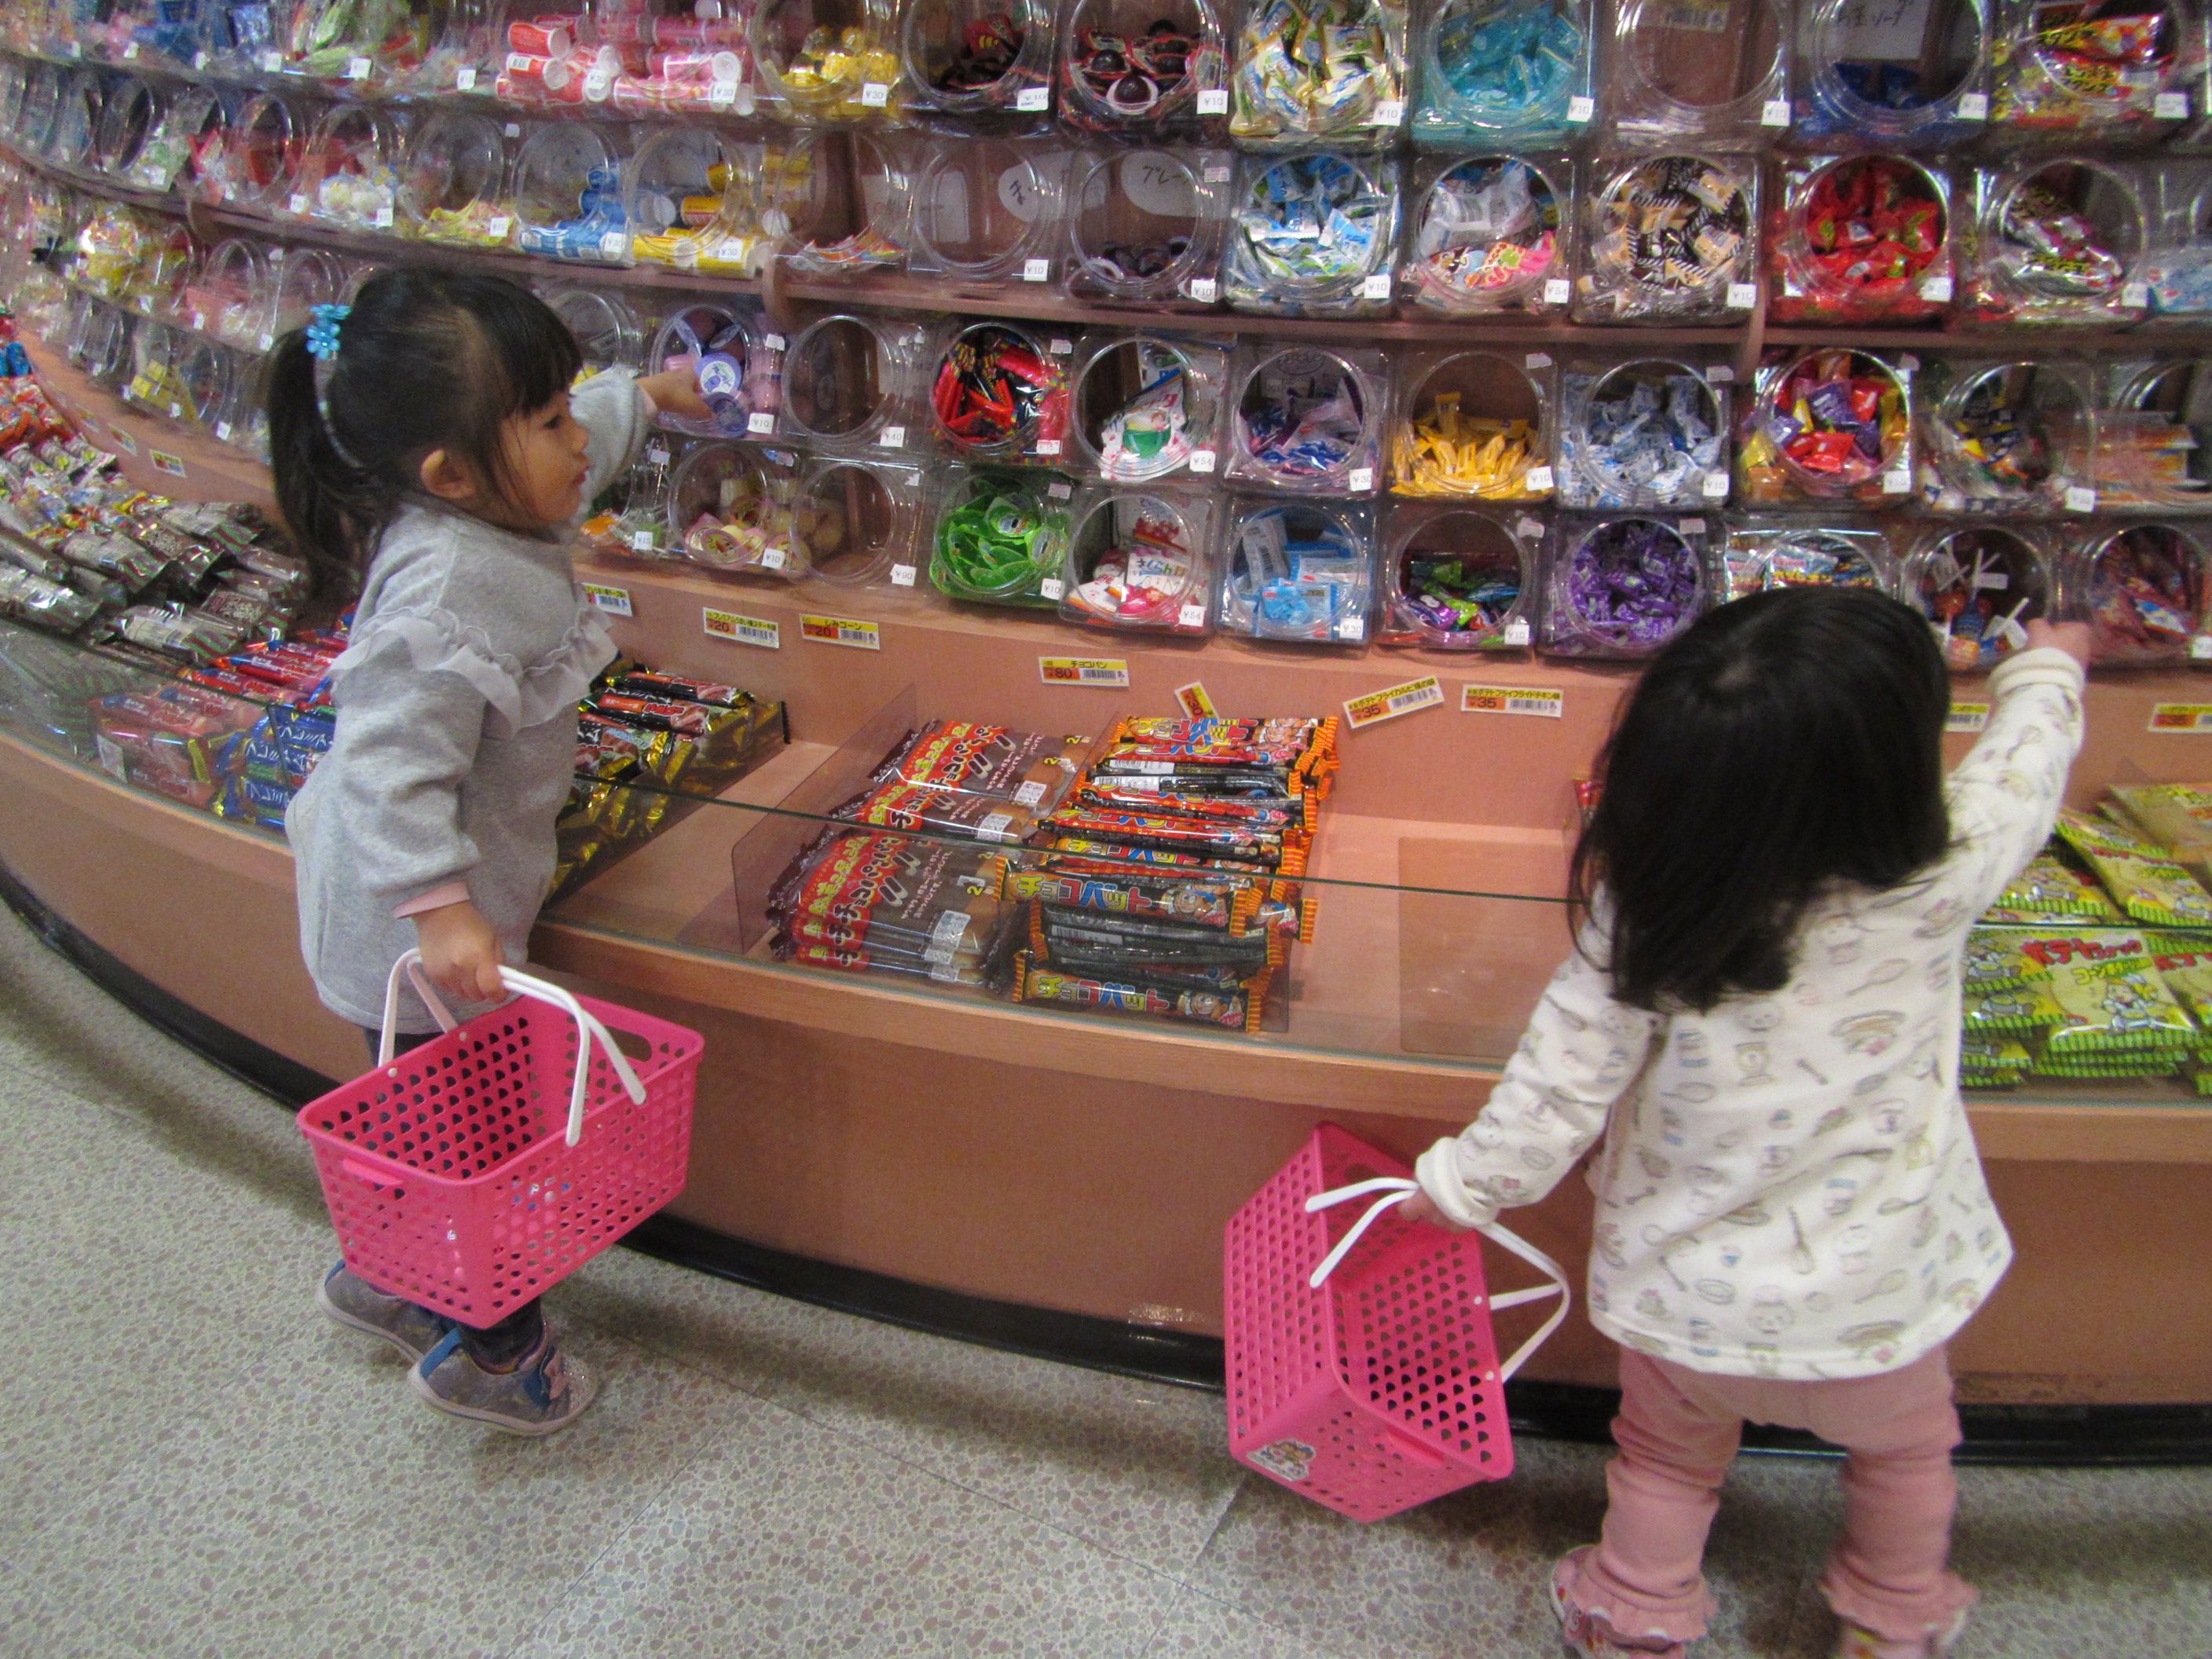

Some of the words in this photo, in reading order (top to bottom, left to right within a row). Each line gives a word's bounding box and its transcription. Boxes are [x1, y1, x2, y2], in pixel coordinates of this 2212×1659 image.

[866, 91, 884, 100] ¥30
[1204, 97, 1223, 106] ¥10
[1378, 108, 1397, 118] ¥10
[1026, 266, 1044, 274] ¥10
[1193, 287, 1212, 295] ¥10
[1368, 283, 1387, 291] ¥10
[754, 419, 769, 427] ¥10
[1532, 474, 1550, 482] ¥10
[766, 555, 781, 563] ¥10
[1044, 584, 1060, 593] ¥10
[1183, 611, 1201, 620] ¥54
[825, 619, 862, 631] しみコーン
[1342, 624, 1362, 633] ¥30
[1507, 630, 1525, 639] ¥10
[1016, 873, 1154, 913] チョコバット
[1037, 974, 1170, 1014] チョコバット
